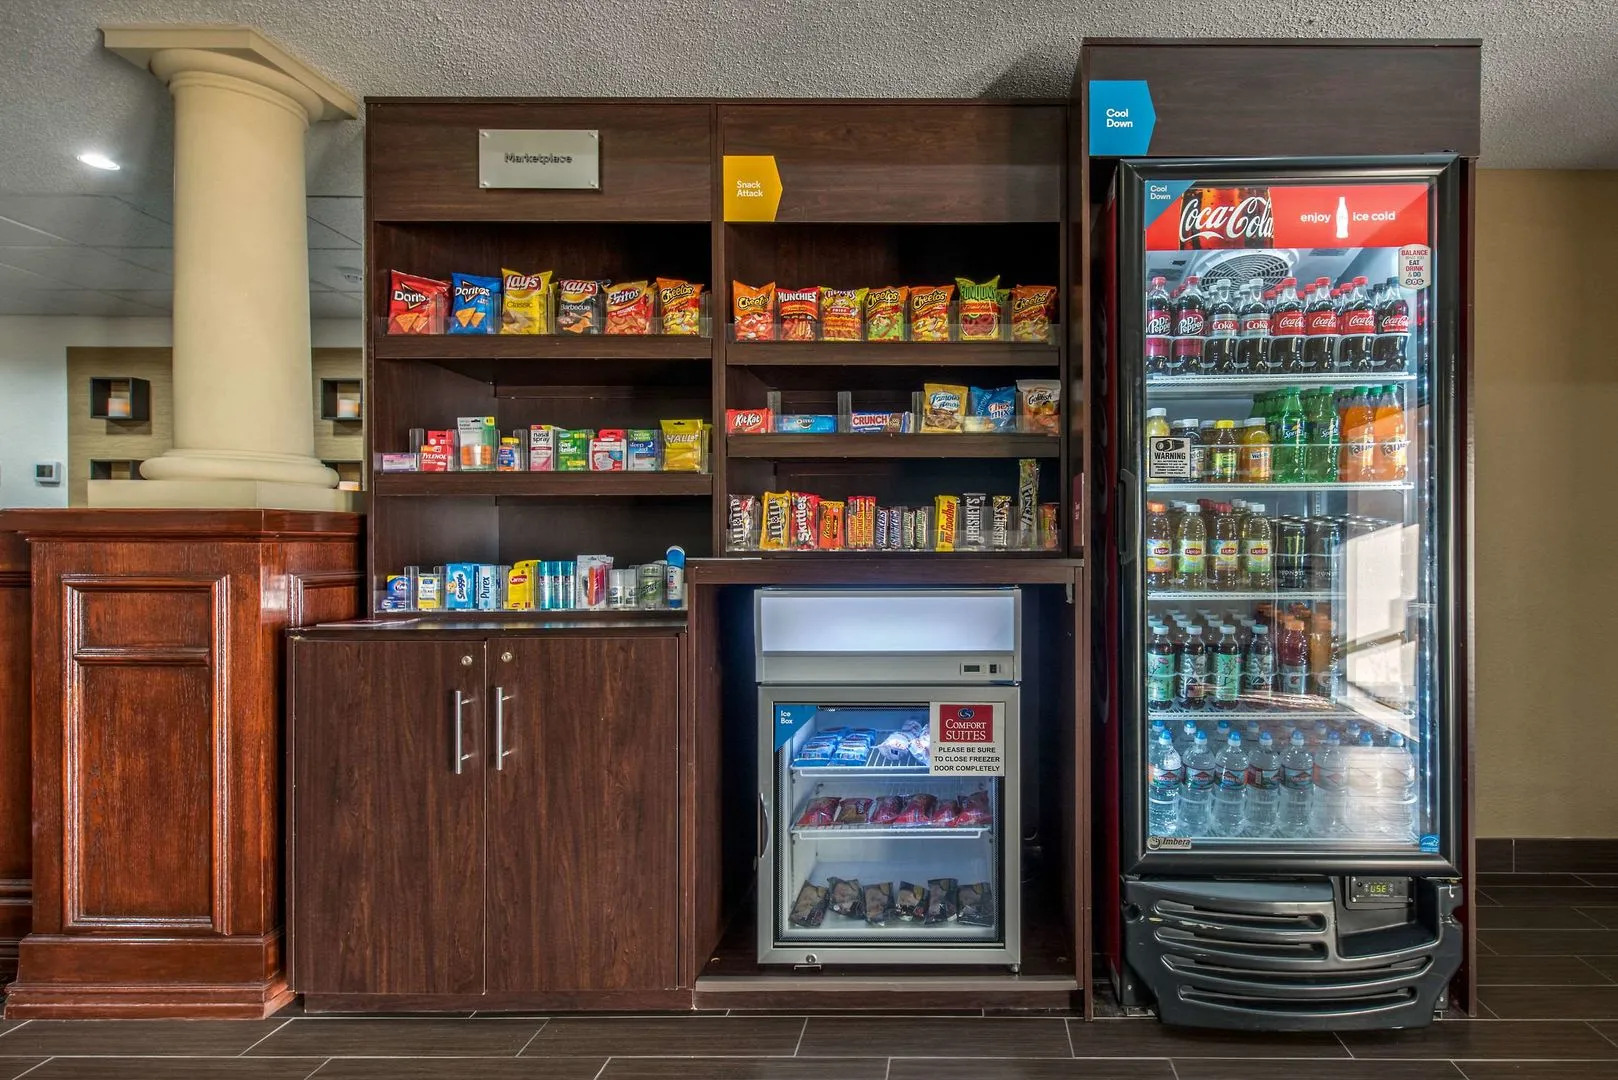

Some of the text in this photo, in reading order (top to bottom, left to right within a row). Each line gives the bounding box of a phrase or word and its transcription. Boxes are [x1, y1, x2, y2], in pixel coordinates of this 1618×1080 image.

[1106, 108, 1129, 118] Cool
[1106, 118, 1133, 128] Down
[504, 152, 573, 166] Marketplace
[736, 180, 760, 190] Snack
[736, 190, 763, 198] Attack
[1300, 210, 1396, 224] enjoy ice cold
[505, 275, 540, 290] Lay's
[660, 286, 694, 302] Cheetos
[778, 291, 817, 302] MUNCHIES
[867, 290, 899, 307] Cheetos
[912, 292, 947, 309] Cheetos
[1212, 320, 1234, 330] Coke
[1246, 320, 1268, 330] Coke
[852, 414, 888, 426] CRUNCH
[480, 576, 490, 599] Purex
[945, 718, 987, 730] COMFORT
[945, 730, 986, 740] SUITES
[1162, 838, 1190, 846] Imbera
